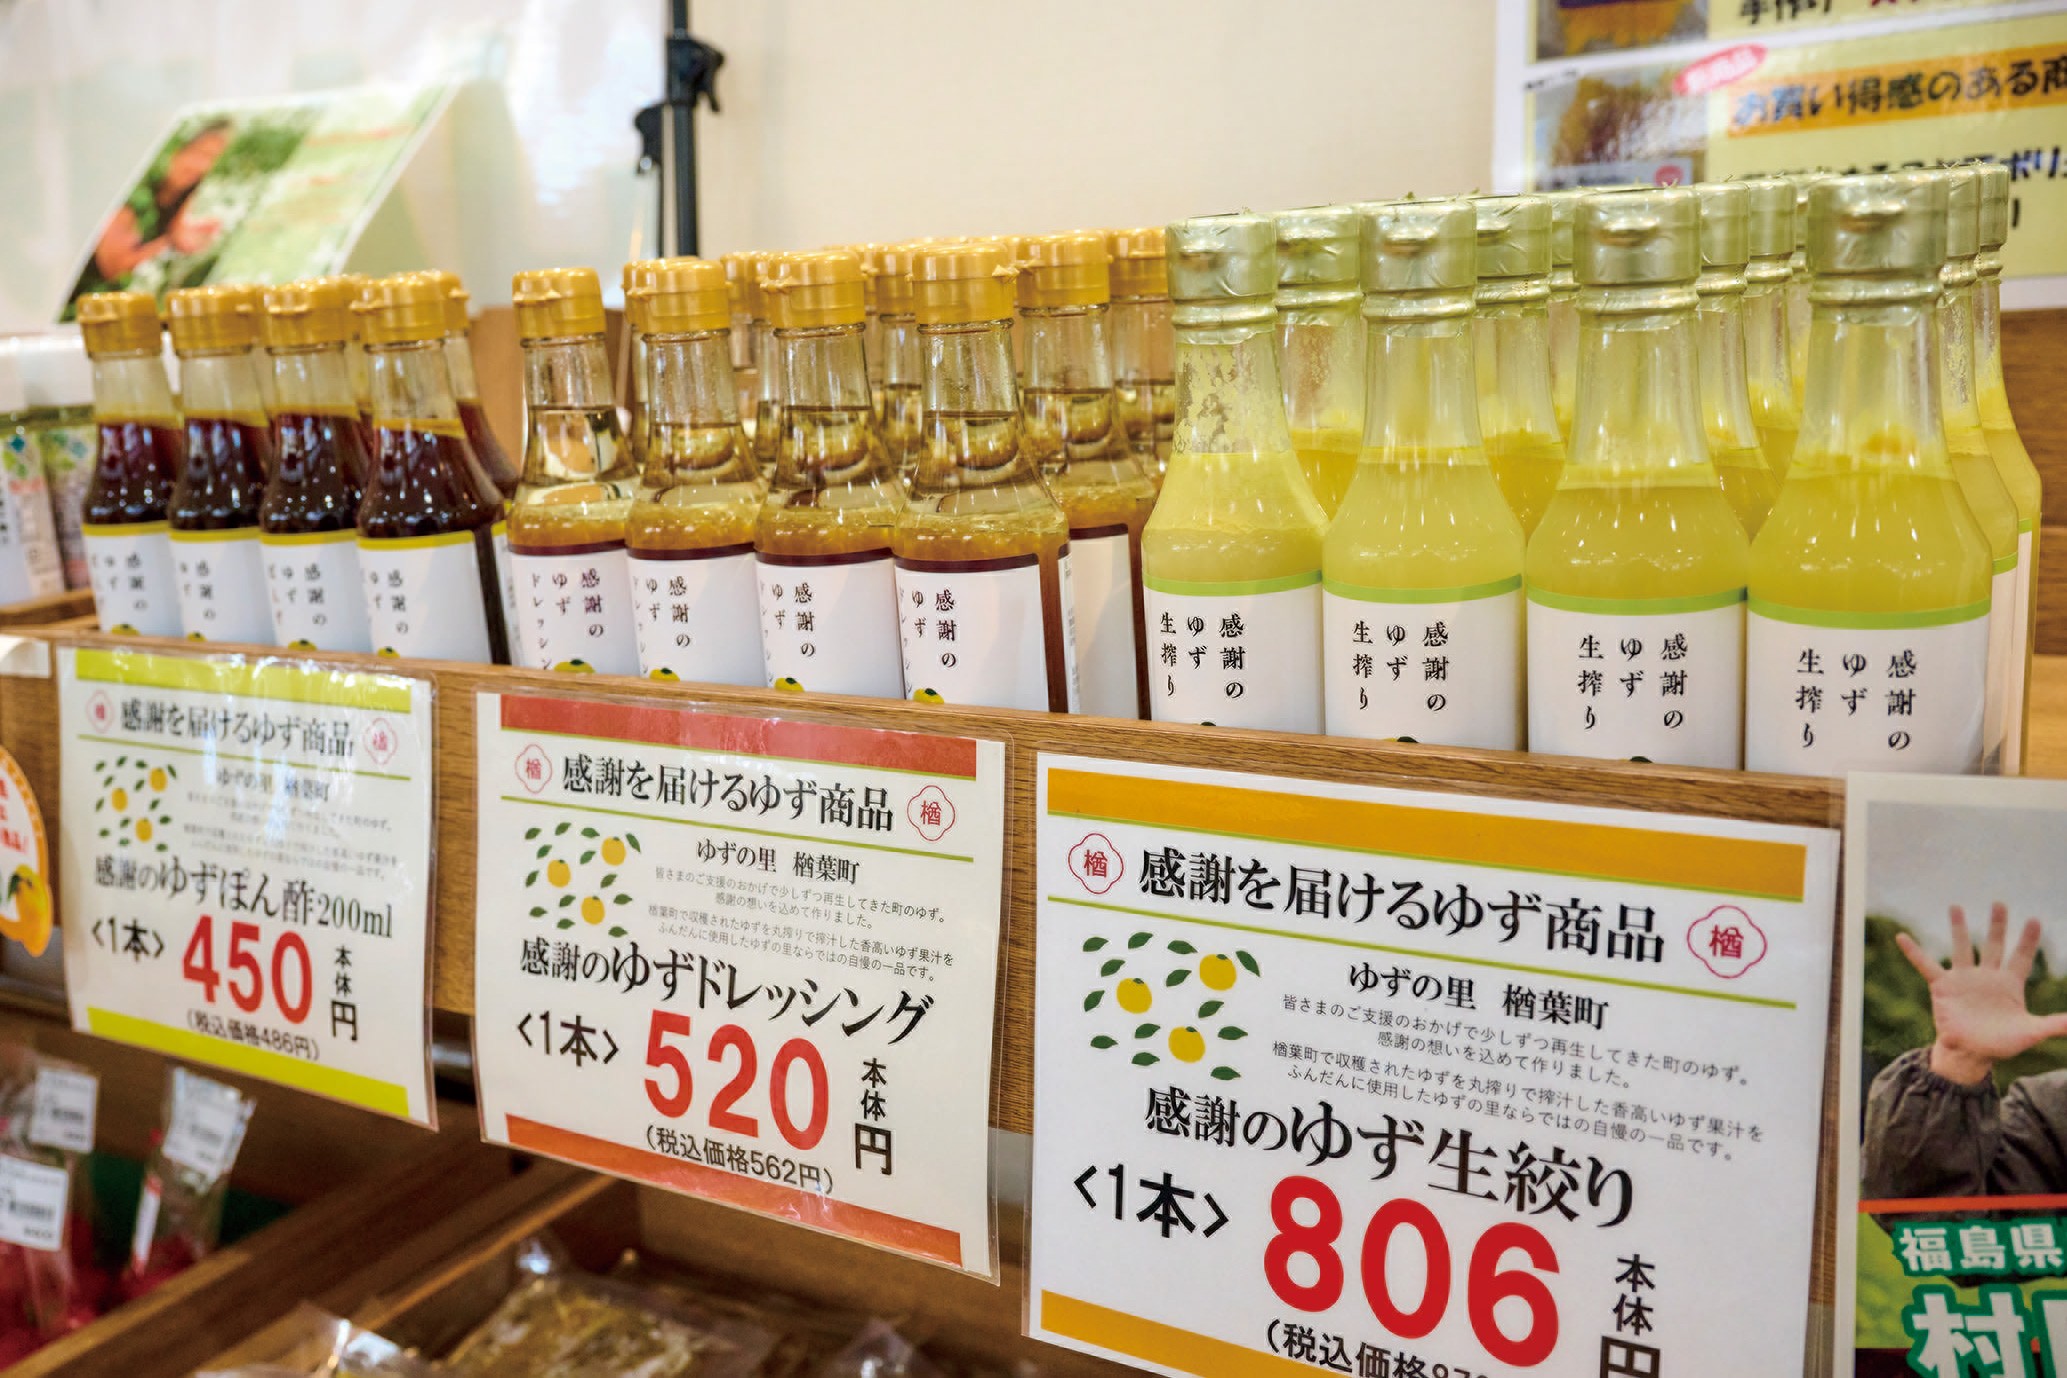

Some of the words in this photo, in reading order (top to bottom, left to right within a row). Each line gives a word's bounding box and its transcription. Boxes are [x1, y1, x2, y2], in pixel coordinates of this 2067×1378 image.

[552, 573, 571, 617] ゆず
[580, 567, 604, 638] 感謝の
[646, 577, 661, 622] ゆず
[668, 575, 692, 649] 感謝の
[772, 583, 786, 630] ゆず
[794, 582, 816, 657] 感謝の
[911, 589, 928, 639] ゆず
[935, 588, 958, 668] 感謝の
[1160, 611, 1177, 697] 生搾り
[1187, 615, 1208, 670] ゆず
[1219, 613, 1247, 700] 感謝の
[1351, 620, 1373, 711] 生搾り
[1385, 624, 1408, 682] ゆず
[1422, 620, 1450, 712] 感謝の
[1618, 636, 1643, 698] ゆず
[1576, 634, 1603, 731] 生搾り
[1659, 632, 1688, 730] 感謝の
[1795, 648, 1825, 751] 生搾り
[1839, 653, 1867, 717] ゆず
[1886, 649, 1917, 752] 感謝の
[121, 697, 354, 758] 感謝を届けるゆず商品
[562, 754, 894, 832] 感謝を届けるゆず商品
[920, 801, 943, 826] 楢
[95, 854, 395, 939] 感謝のゆずぽん酢200ml
[655, 866, 946, 924] 皆さまのご支援のおかげで少しずつ再生してきた町のゆず。
[696, 838, 777, 874] ゆずの里
[792, 852, 860, 885] 楢葉町
[1083, 849, 1108, 879] 楢
[715, 892, 874, 930] 感謝の想いを込めて作りました。
[1138, 848, 1665, 964] 感謝を届けるゆず商品
[1708, 925, 1744, 961] 楢
[182, 913, 313, 1025] 450
[657, 922, 936, 983] ふんだんに使用したゆずの里ならではの自慢の一品です。
[331, 945, 358, 1042] 本体円
[520, 937, 934, 1046] 感謝のゆずドレッシング
[1348, 962, 1477, 1012] ゆずの里
[1502, 983, 1609, 1031] 楢葉町
[187, 1007, 320, 1062] (税込価格486円)
[1282, 993, 1750, 1087] 皆さまのご支援のおかげで少しずつ再生してきた町のゆず。
[1376, 1031, 1634, 1090] 感謝の想いを込めて作りました。
[644, 1009, 829, 1151] 520
[853, 1058, 893, 1176] 本体円
[1271, 1040, 1765, 1143] 楢葉町で収穫されたゆずを丸搾りで搾汁した香高いゆず果汁を
[1287, 1065, 1734, 1162] ふんだんに使用したゆずの里ならではの自慢の一品です。
[647, 1125, 833, 1195] (税込価格562円)
[1143, 1085, 1637, 1230] 感謝のゆず生絞り
[1263, 1175, 1561, 1368] 806
[1899, 1223, 2064, 1272] 福島県
[1266, 1318, 1490, 1378] (税込価格
[1911, 1291, 2067, 1378] 村
